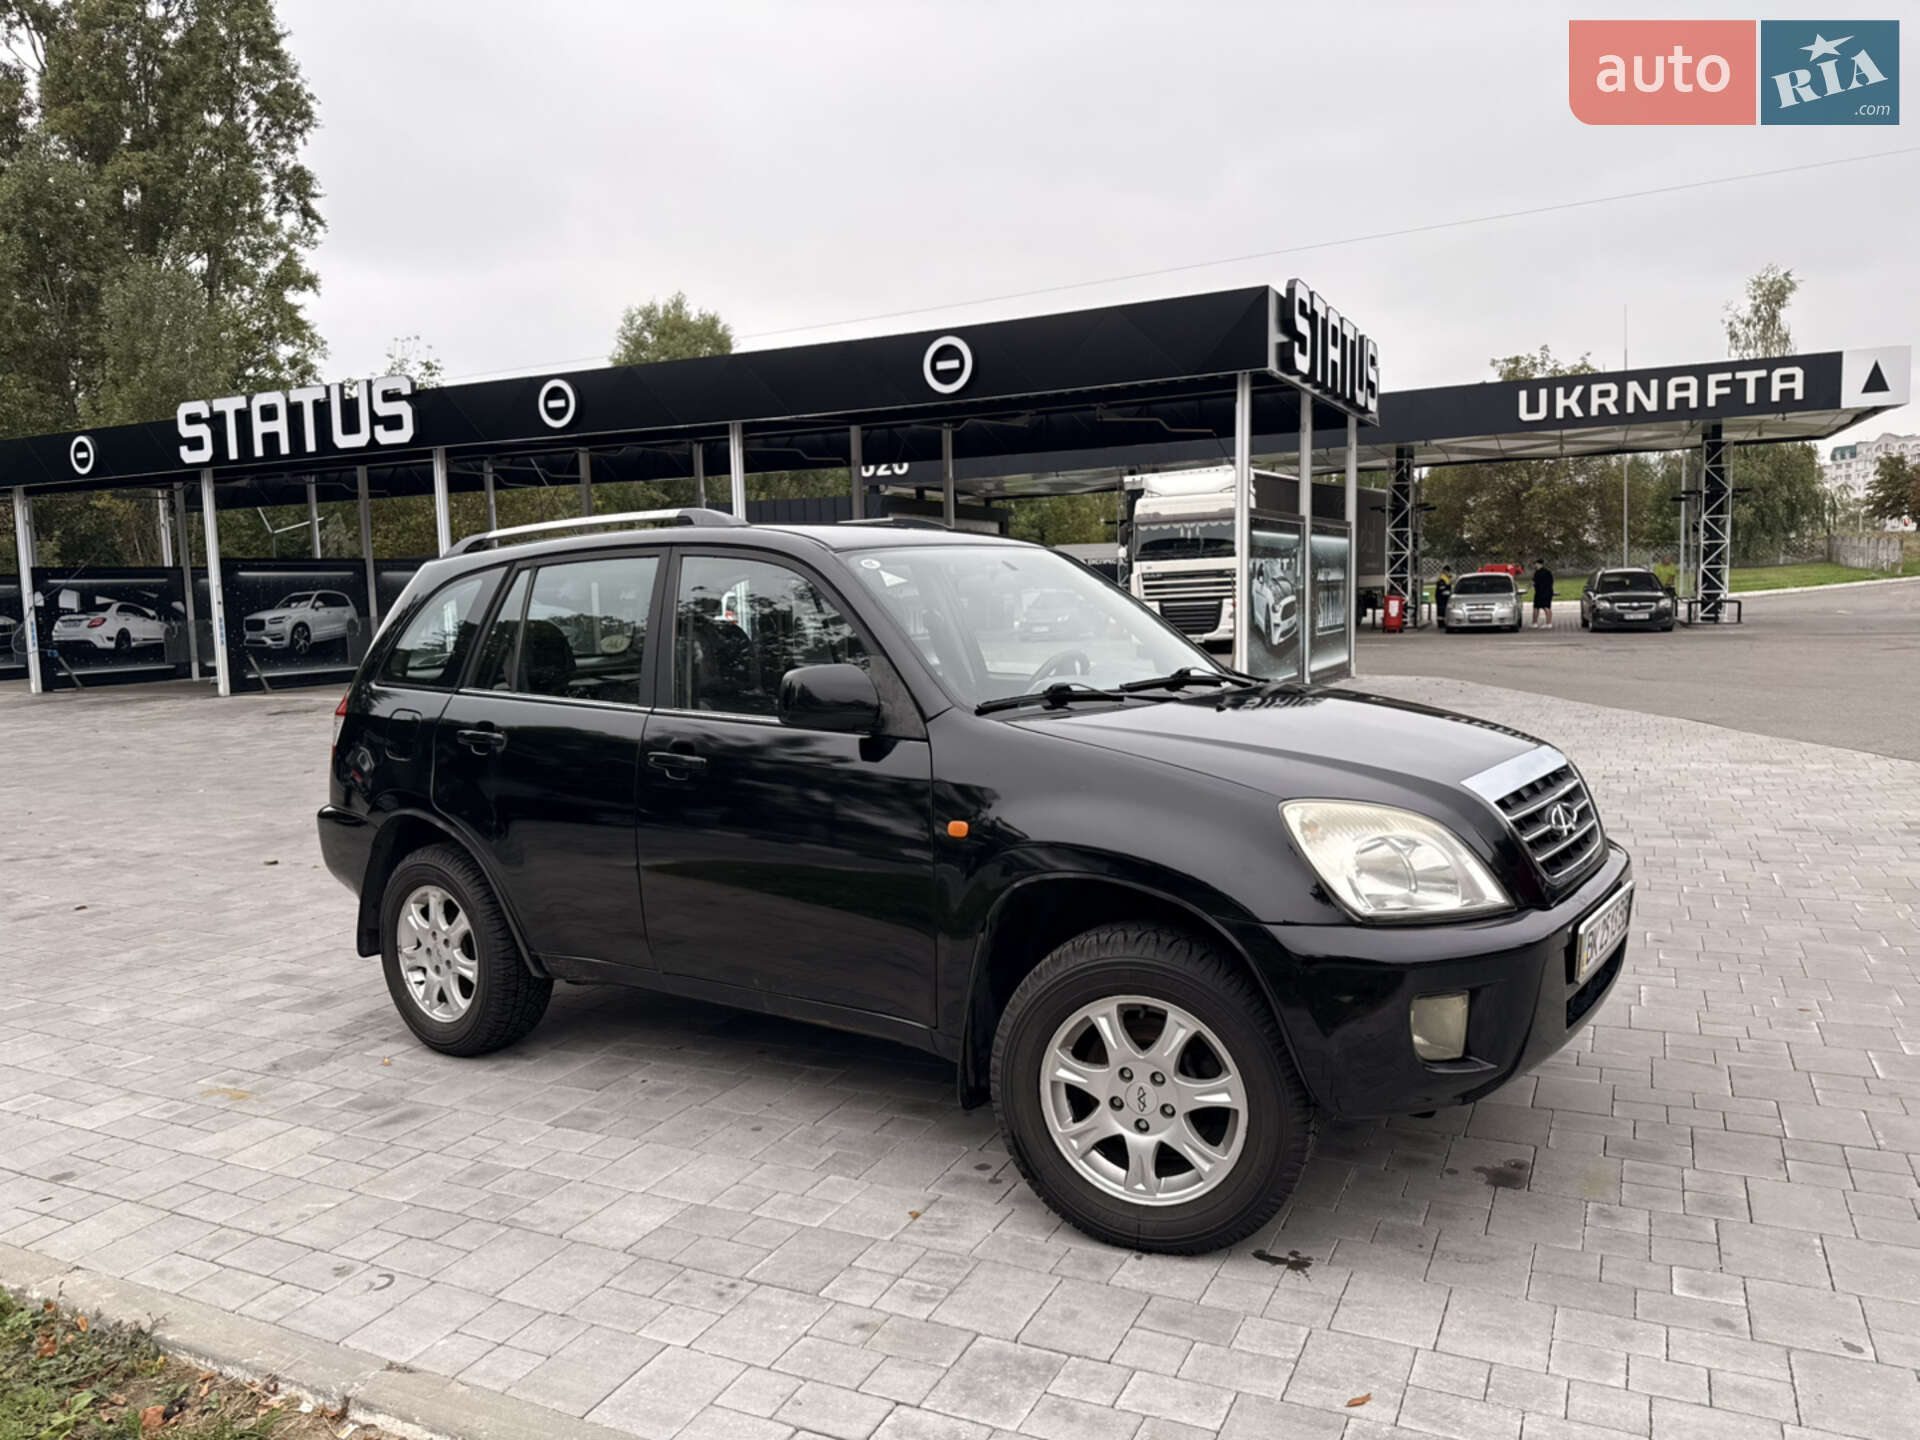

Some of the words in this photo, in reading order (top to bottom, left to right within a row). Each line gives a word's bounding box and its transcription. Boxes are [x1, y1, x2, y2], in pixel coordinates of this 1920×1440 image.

[1292, 278, 1379, 413] STATUS
[176, 375, 416, 464] STATUS
[1518, 366, 1805, 422] UKRNAFTA
